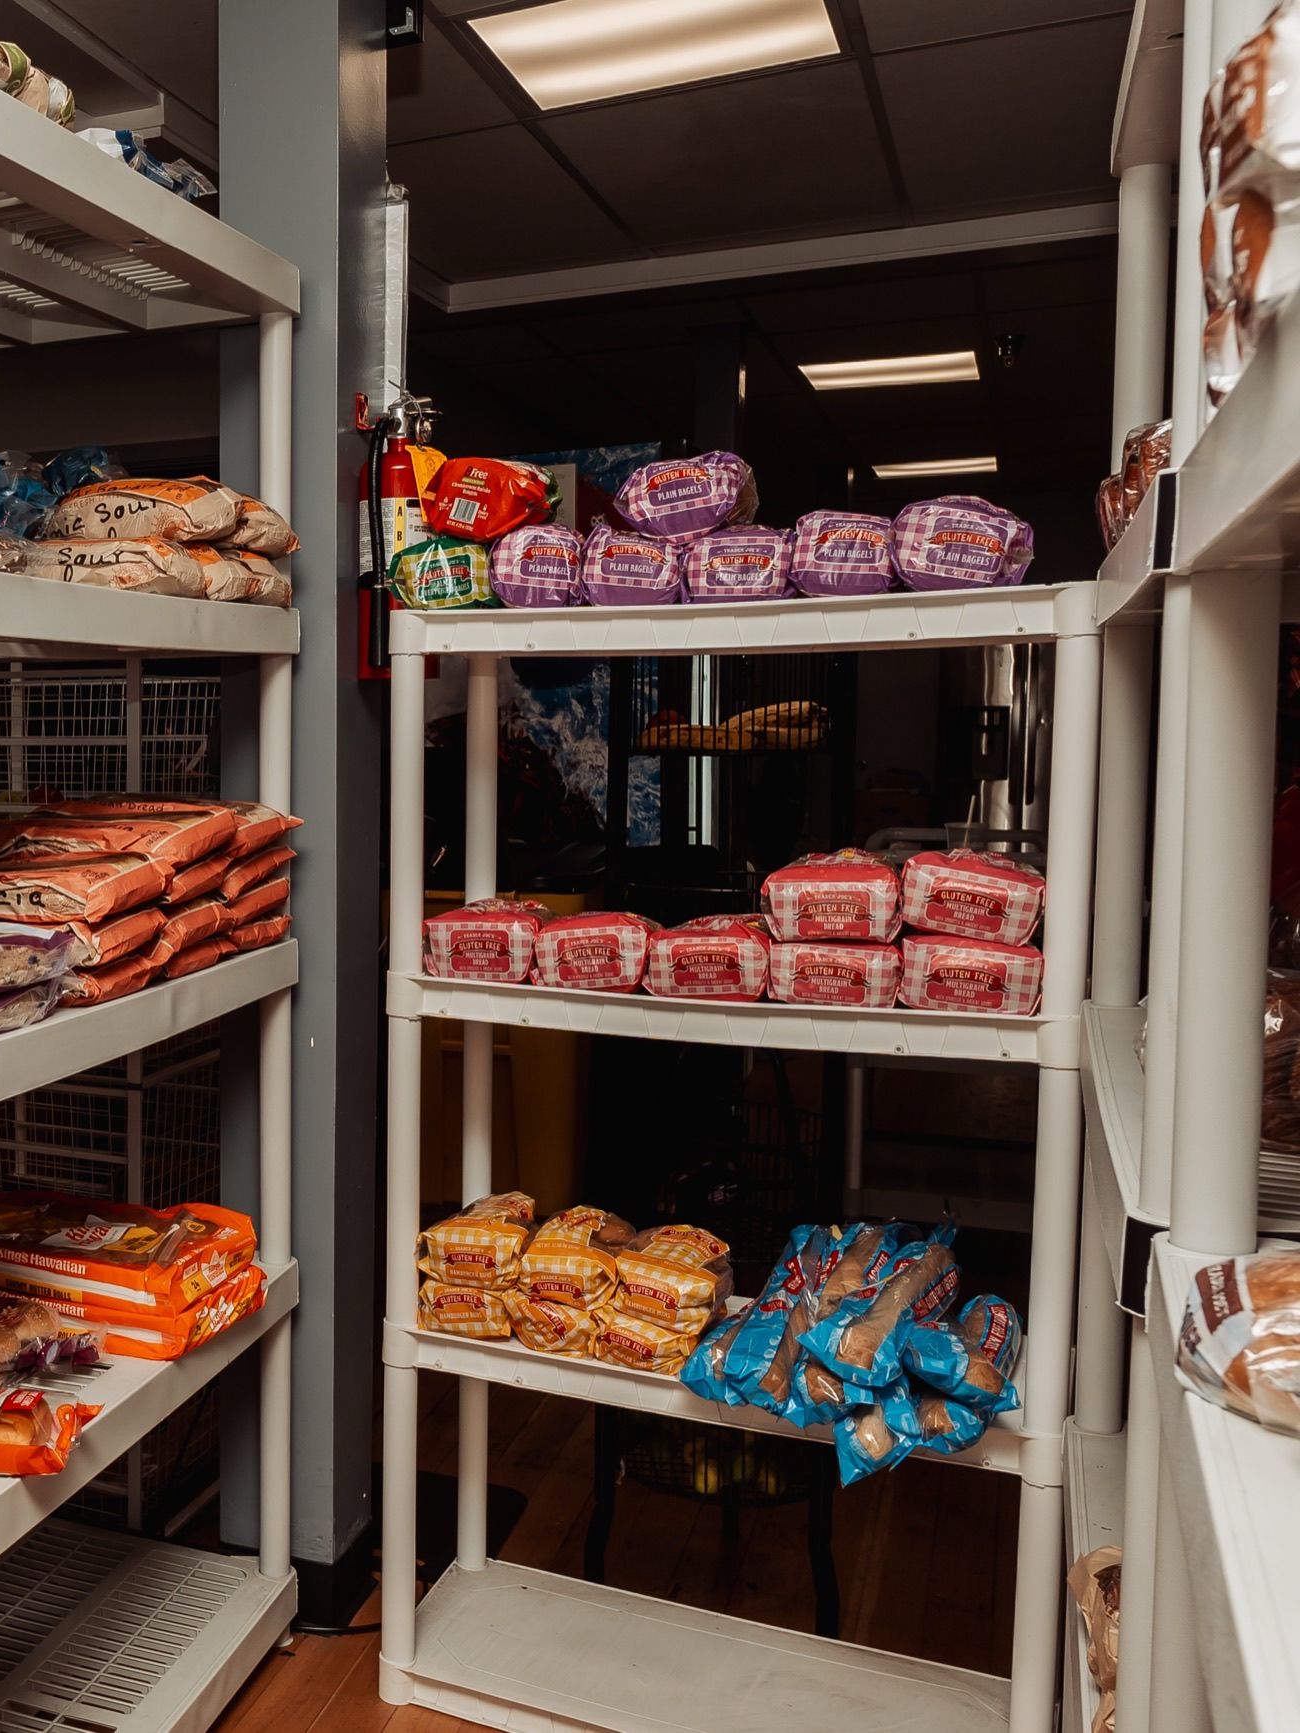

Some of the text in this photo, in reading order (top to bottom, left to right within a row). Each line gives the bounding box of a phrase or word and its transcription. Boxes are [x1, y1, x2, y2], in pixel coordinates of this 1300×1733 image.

[654, 468, 701, 484] GLUTEN FREE
[657, 485, 702, 501] PLAIN BAGELS
[397, 507, 403, 517] A
[397, 531, 403, 541] B
[826, 530, 857, 541] GLUTEN
[942, 532, 996, 548] GLUTEN FREE
[611, 546, 637, 554] GLUTEN
[824, 549, 873, 560] PLAIN BAGELS
[58, 548, 124, 565] Sour
[747, 556, 765, 564] FREE
[936, 551, 990, 567] PLAIN BAGELS
[528, 564, 548, 573] PLAIN
[609, 562, 654, 574] PLAIN BAGELS
[940, 891, 996, 909] GLUTEN FREE
[808, 904, 860, 914] GLUTEN FREE
[946, 902, 985, 916] MULTIGRAIN
[815, 915, 852, 923] MULTIGRAIN
[953, 911, 975, 921] BREAD
[459, 941, 501, 951] GLUTEN FREE
[465, 951, 496, 959] MULTIGRAIN
[566, 947, 611, 958] GLUTEN FREE
[572, 958, 606, 967] MULTIGRAIN
[681, 955, 730, 965] GLUTEN FREE
[689, 965, 724, 973] MULTIGRAIN
[804, 967, 857, 979] GLUTEN FREE
[939, 969, 995, 984] GLUTEN FREE
[811, 978, 848, 987] MULTIGRAIN
[945, 980, 985, 992] MULTIGRAIN
[819, 986, 839, 994] BREAD
[953, 989, 975, 998] BREAD
[451, 1253, 490, 1264] GLUTEN FREE
[30, 1254, 86, 1276] Hawaiian
[53, 1288, 71, 1301] ROLLS
[441, 1296, 478, 1304] GLUTEN FREE
[629, 1286, 672, 1304] GLUTEN FREE
[609, 1334, 648, 1355] GLUTEN FREE
